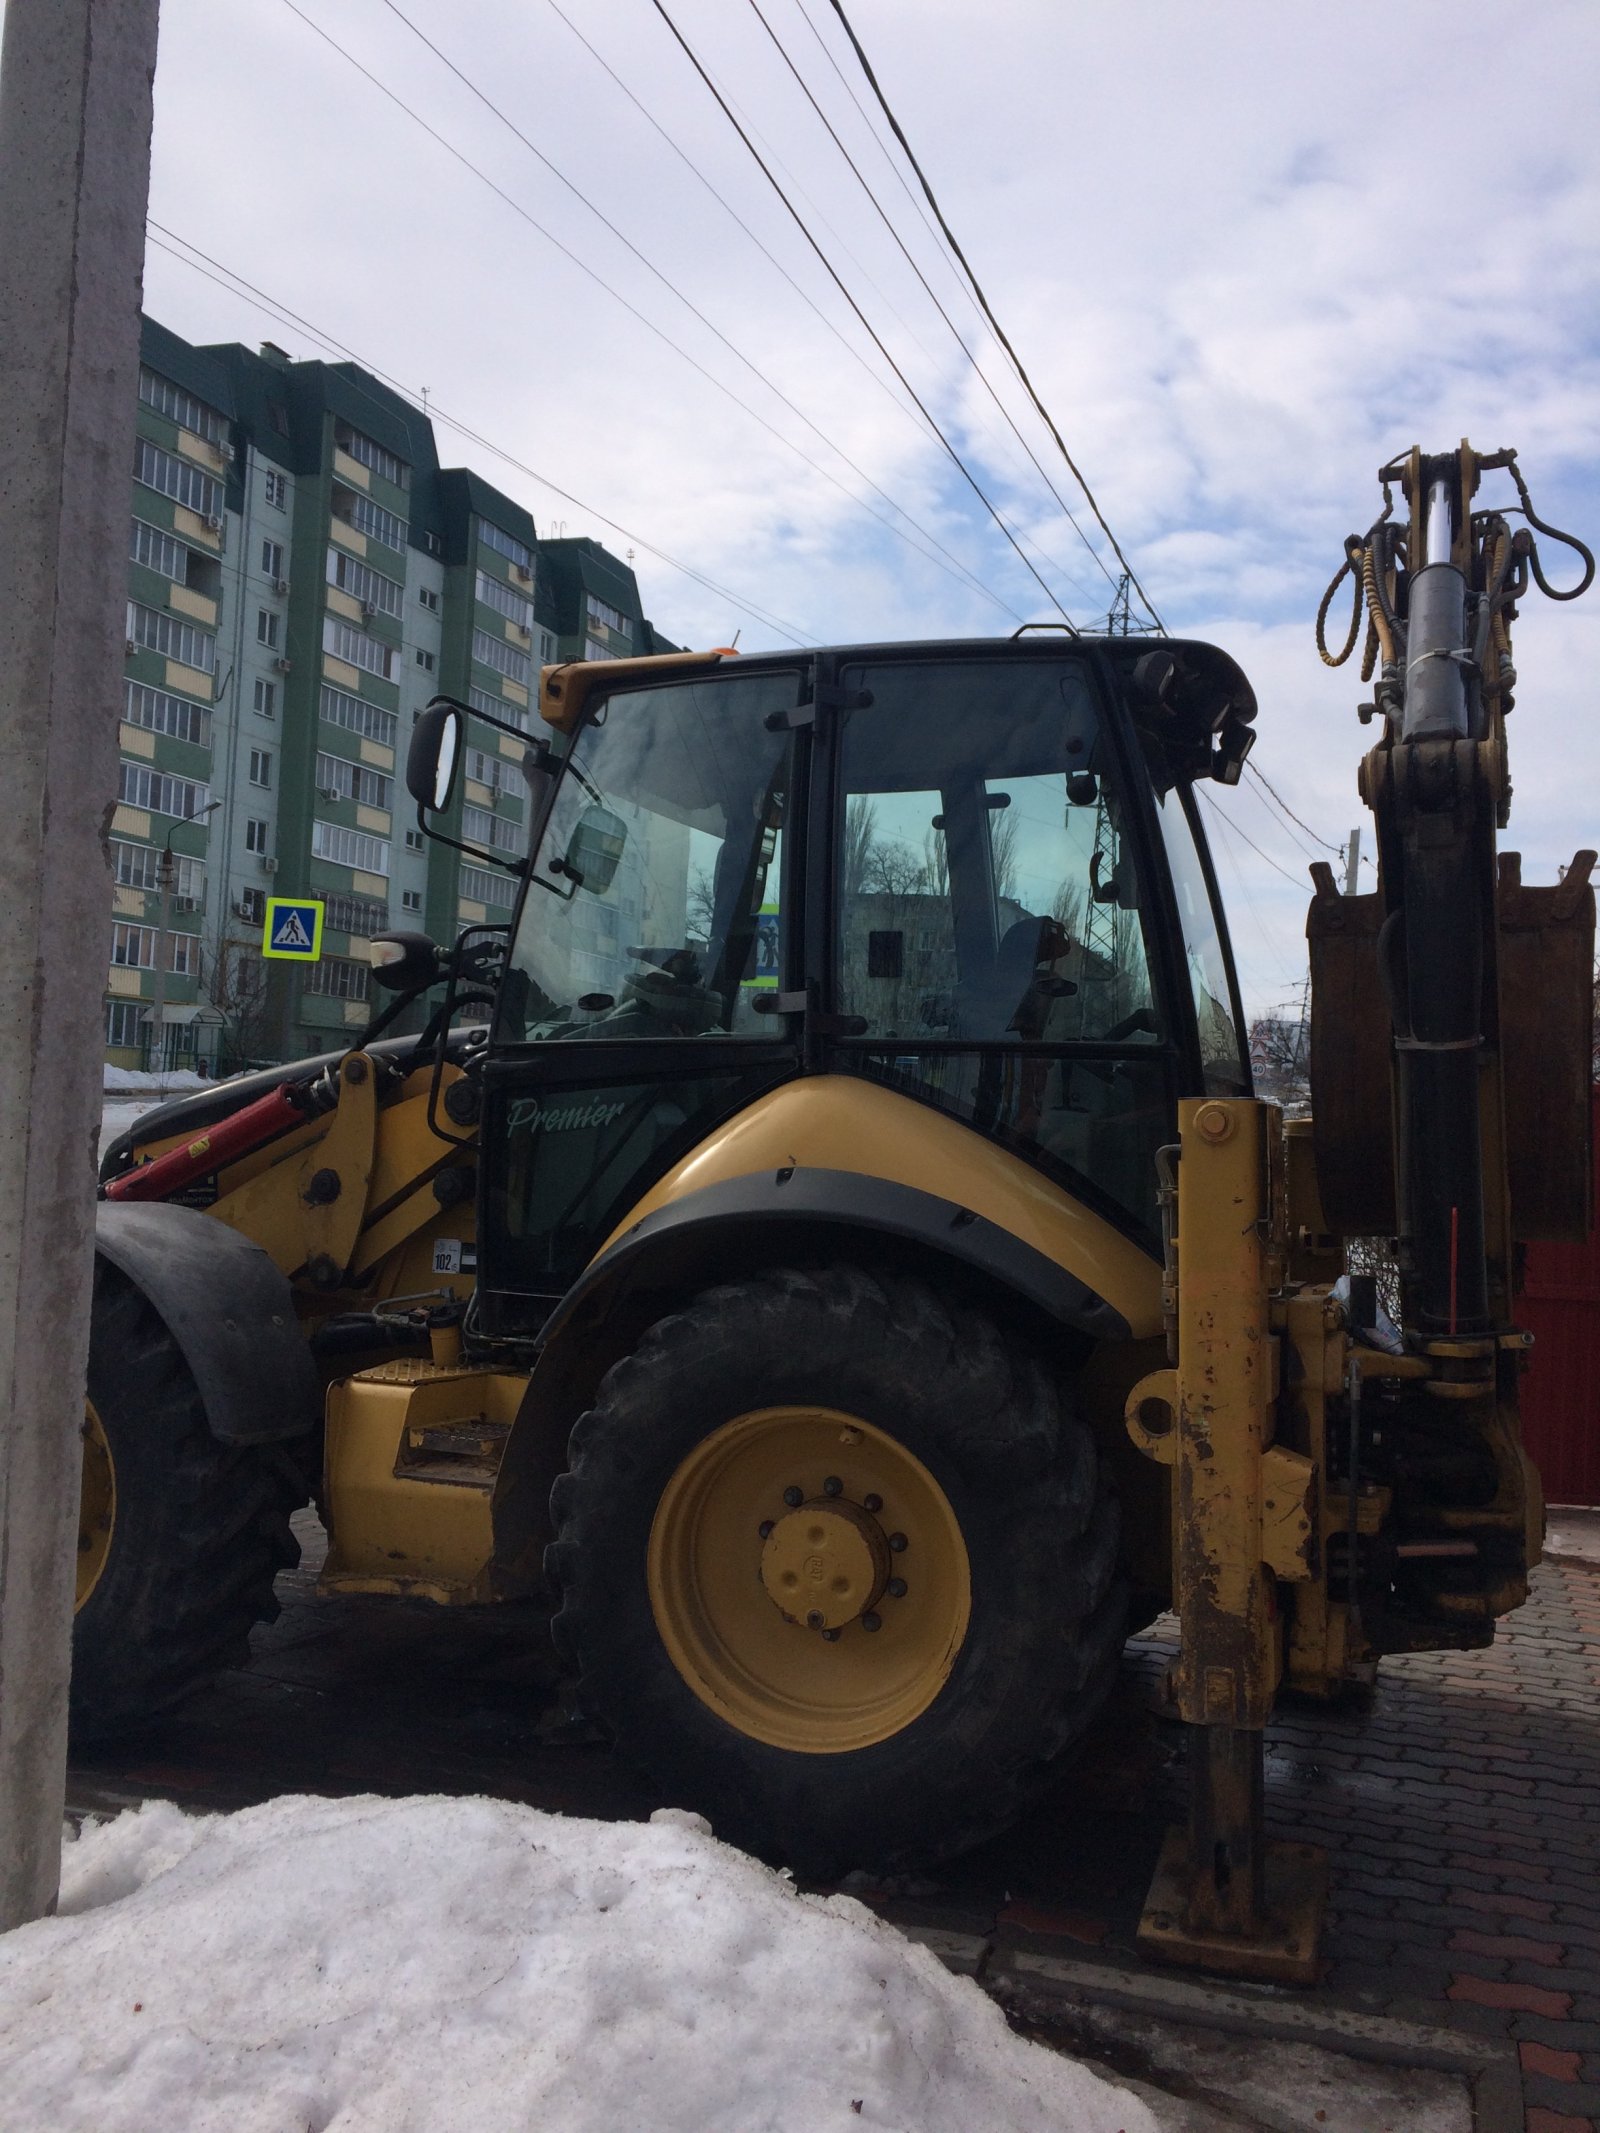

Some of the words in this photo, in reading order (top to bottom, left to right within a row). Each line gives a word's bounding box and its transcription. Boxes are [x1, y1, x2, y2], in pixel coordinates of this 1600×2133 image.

[1253, 1066, 1263, 1074] 40
[506, 1096, 625, 1138] Premier
[436, 1254, 452, 1271] 102
